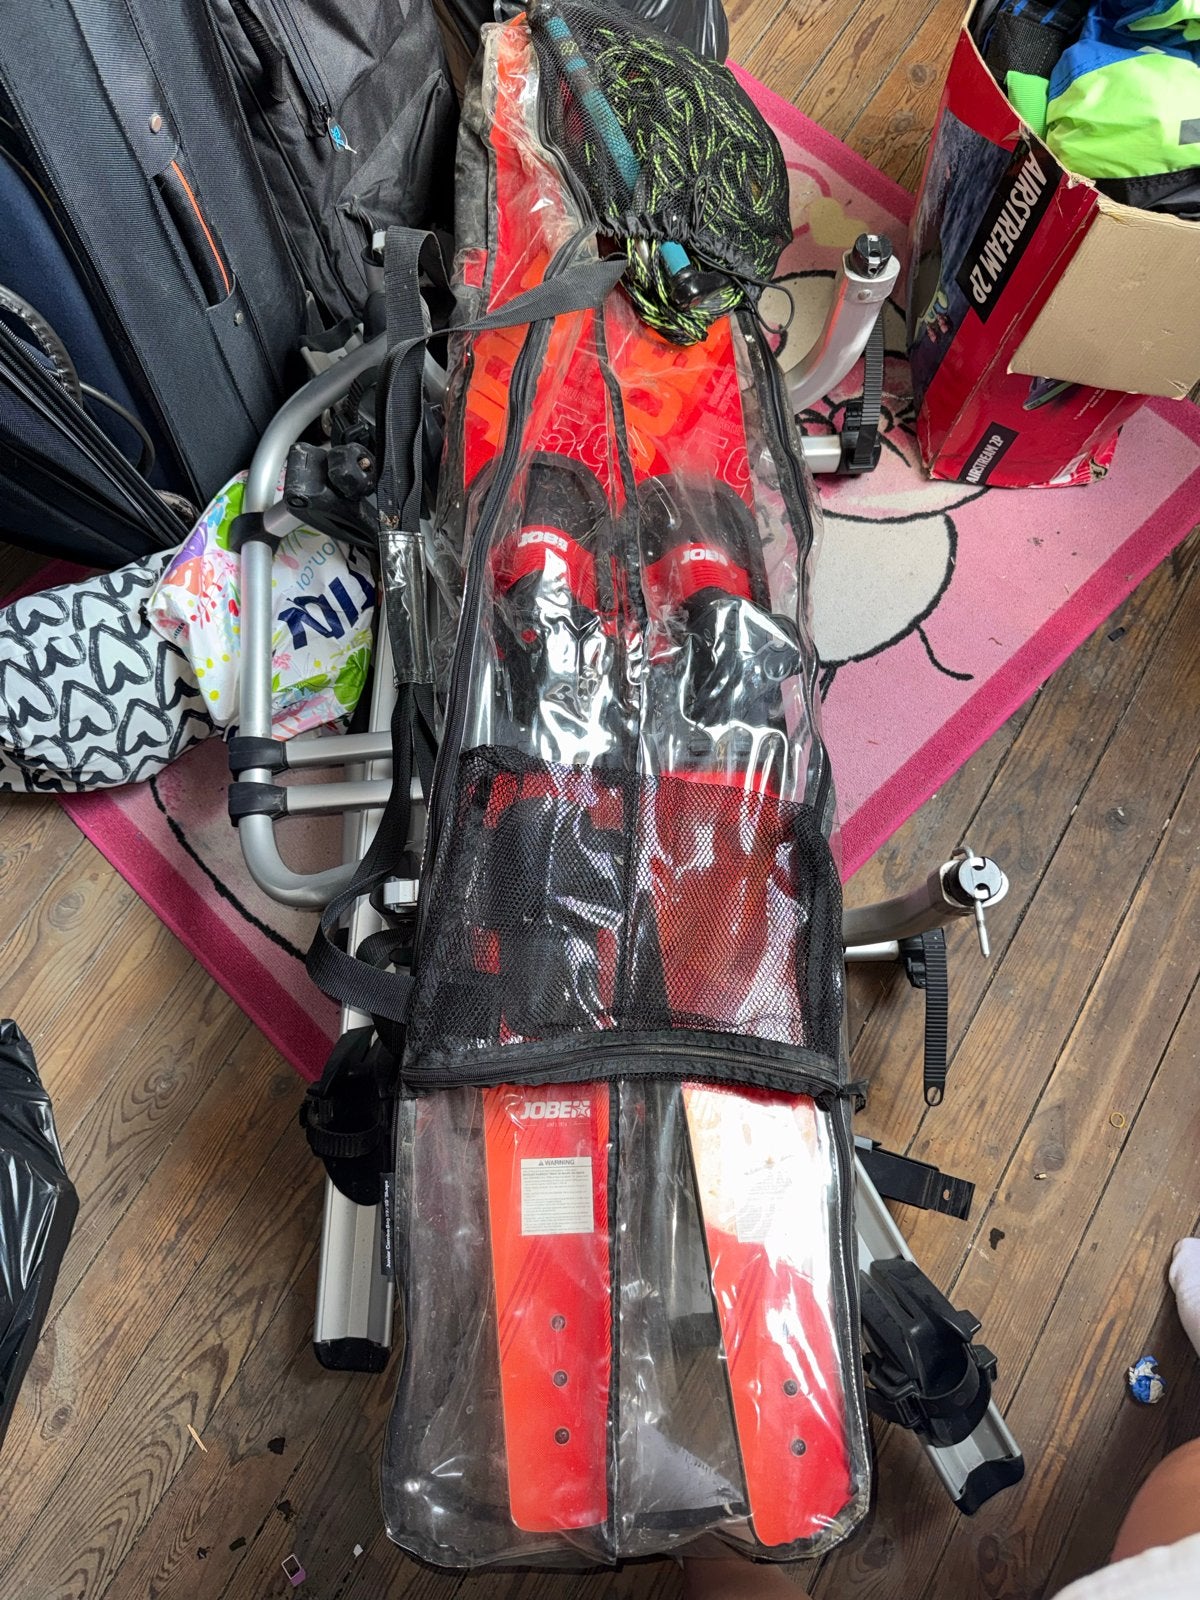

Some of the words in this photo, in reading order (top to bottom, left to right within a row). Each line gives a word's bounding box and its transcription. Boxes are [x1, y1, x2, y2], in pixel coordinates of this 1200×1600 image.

[979, 151, 1048, 282] AIRSTREAM
[969, 265, 992, 304] 2P
[965, 443, 1000, 484] AIRSTREAM
[988, 434, 1004, 447] 2P
[520, 1101, 571, 1120] JOBE
